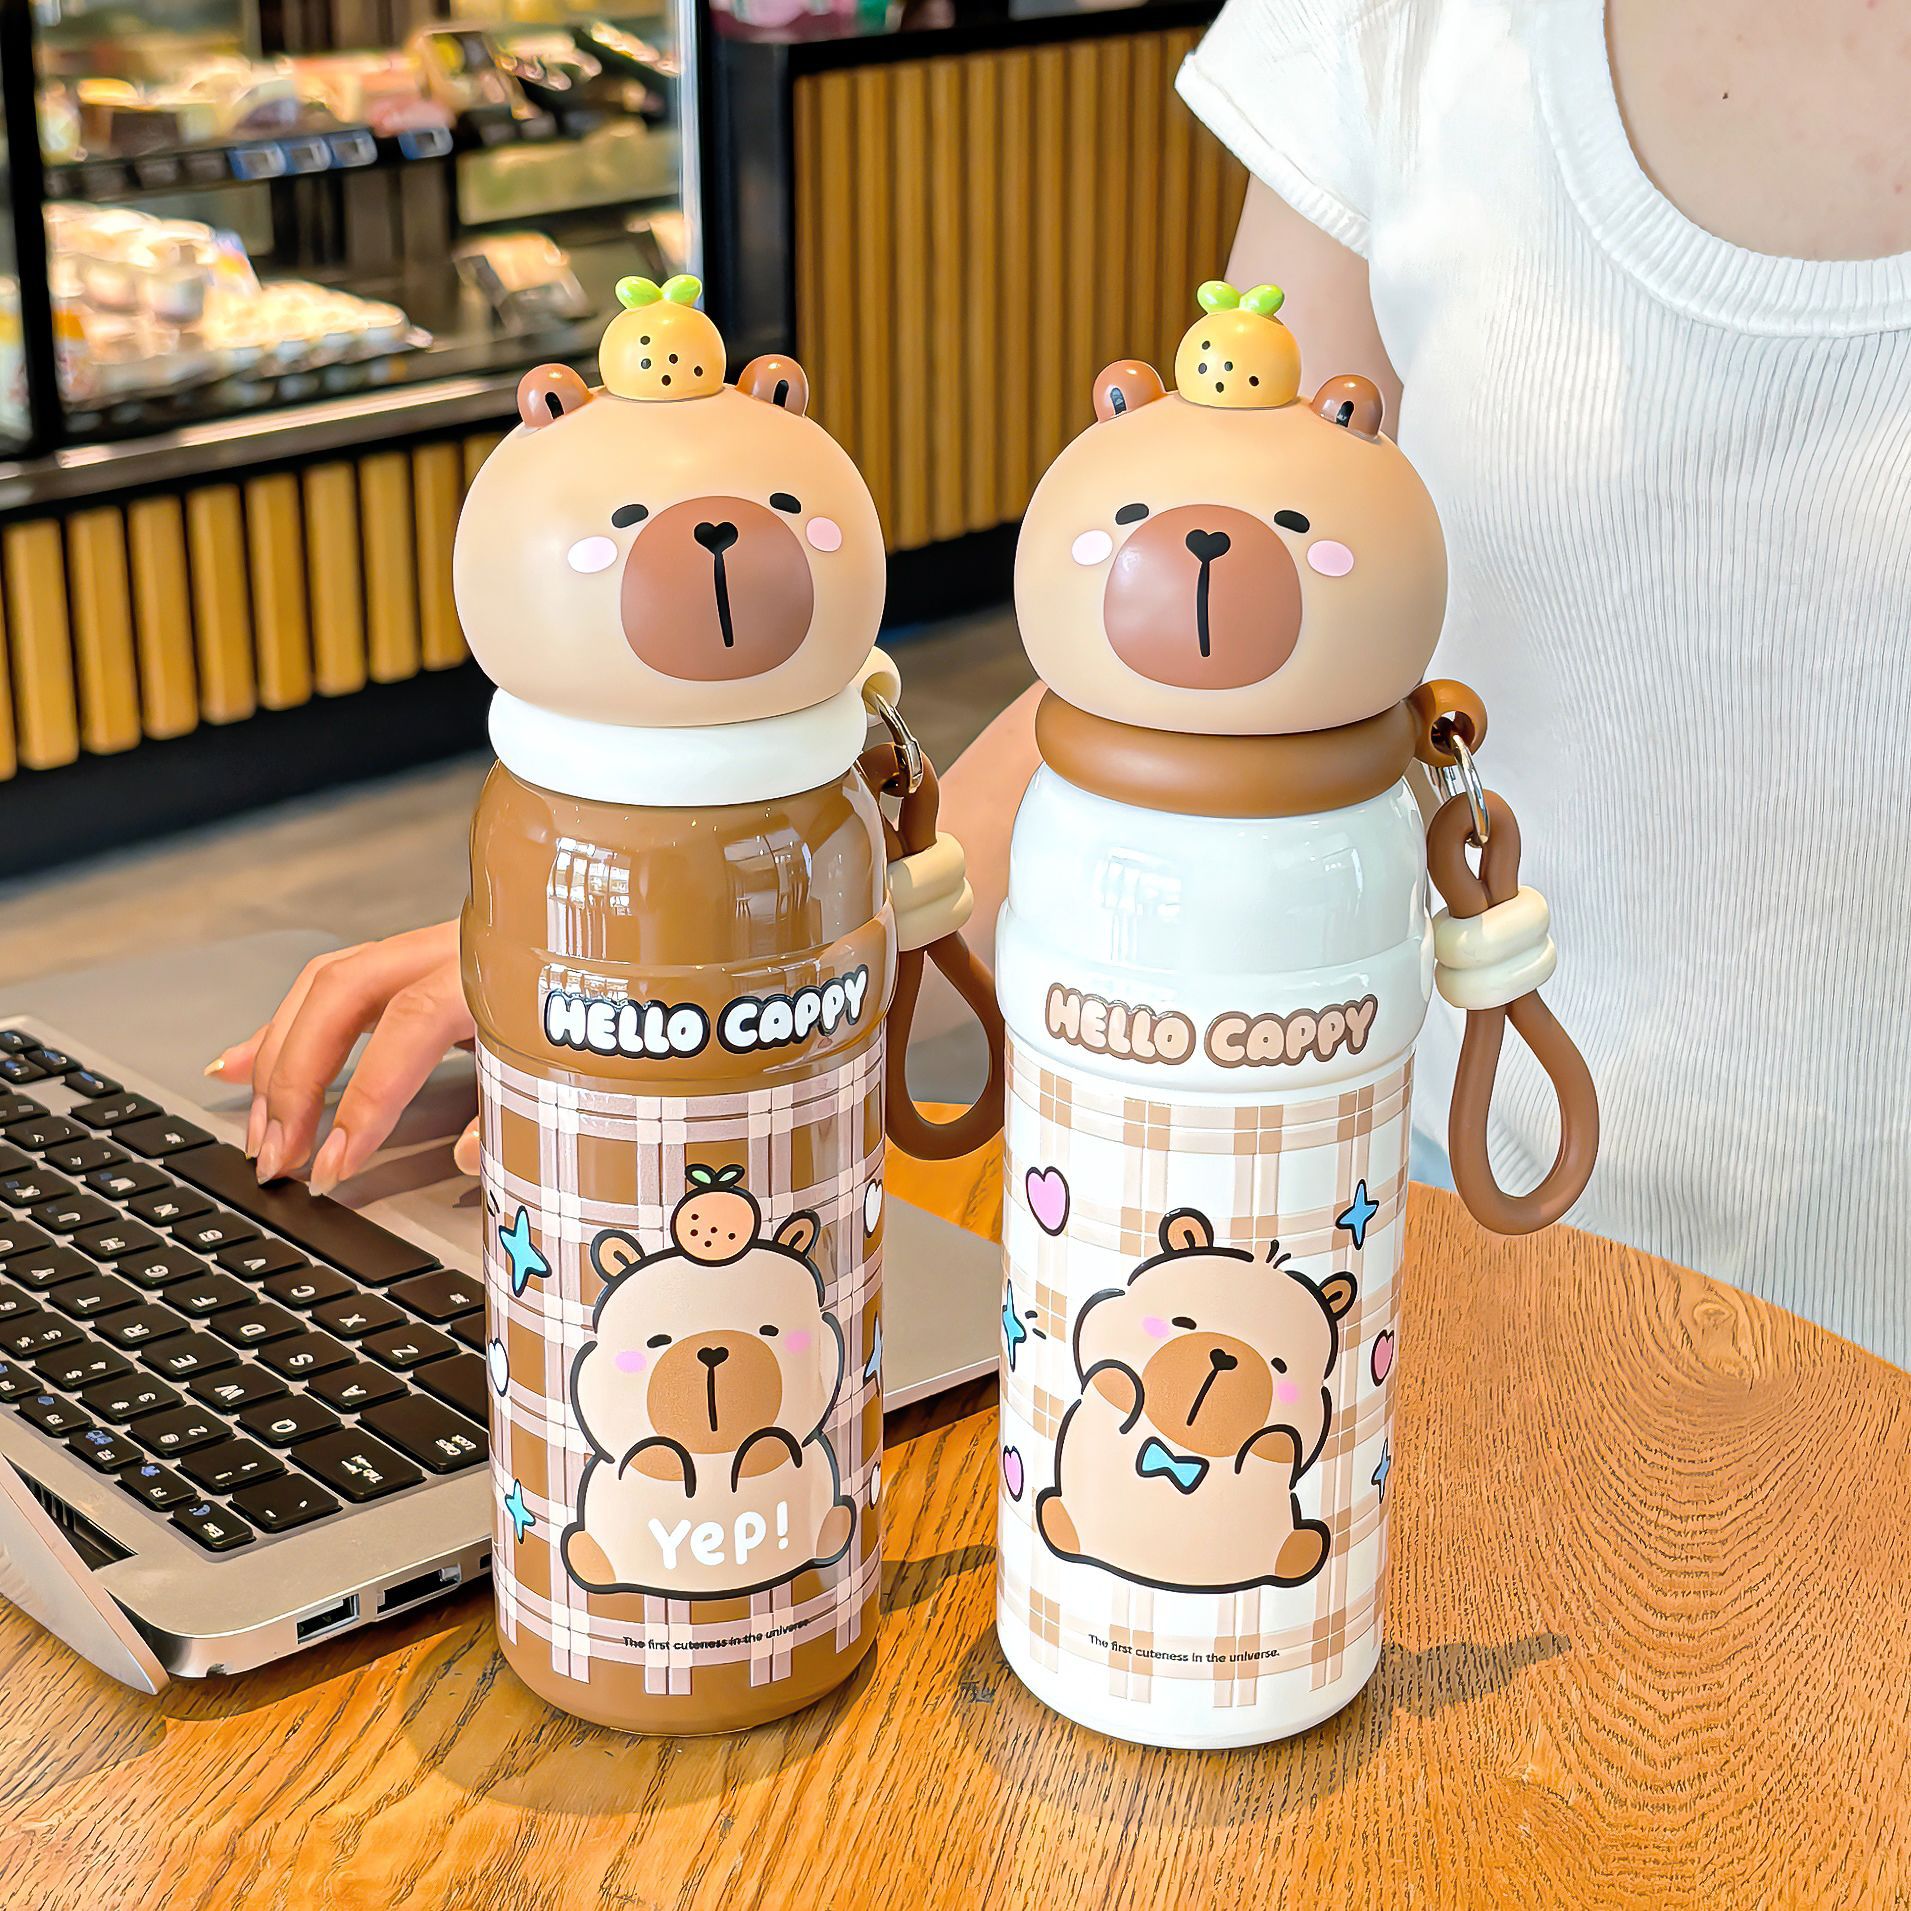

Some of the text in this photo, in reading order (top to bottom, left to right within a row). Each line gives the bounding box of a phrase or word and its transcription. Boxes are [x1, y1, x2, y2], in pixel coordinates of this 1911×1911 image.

[544, 963, 870, 1060] HELLO CAPPY
[1045, 982, 1379, 1069] HELLO CAPPY
[144, 1264, 169, 1278] G
[243, 1258, 267, 1271] V
[30, 1267, 56, 1280] Y
[290, 1285, 316, 1298] C
[76, 1296, 101, 1308] T
[338, 1313, 367, 1328] X
[123, 1323, 150, 1338] R
[240, 1323, 267, 1337] D
[391, 1344, 419, 1359] Z
[169, 1354, 198, 1369] E
[289, 1353, 314, 1366] S
[214, 1384, 245, 1400] W
[341, 1384, 367, 1398] A
[188, 1424, 208, 1437] 2
[270, 1418, 298, 1434] Q
[622, 1635, 646, 1649] The
[647, 1638, 671, 1651] first
[672, 1638, 727, 1651] cuteness
[742, 1632, 763, 1645] the
[1087, 1633, 1109, 1649] The
[1110, 1640, 1133, 1655] first
[1134, 1648, 1189, 1663] cuteness
[1191, 1651, 1203, 1663] in
[1205, 1652, 1227, 1663] the
